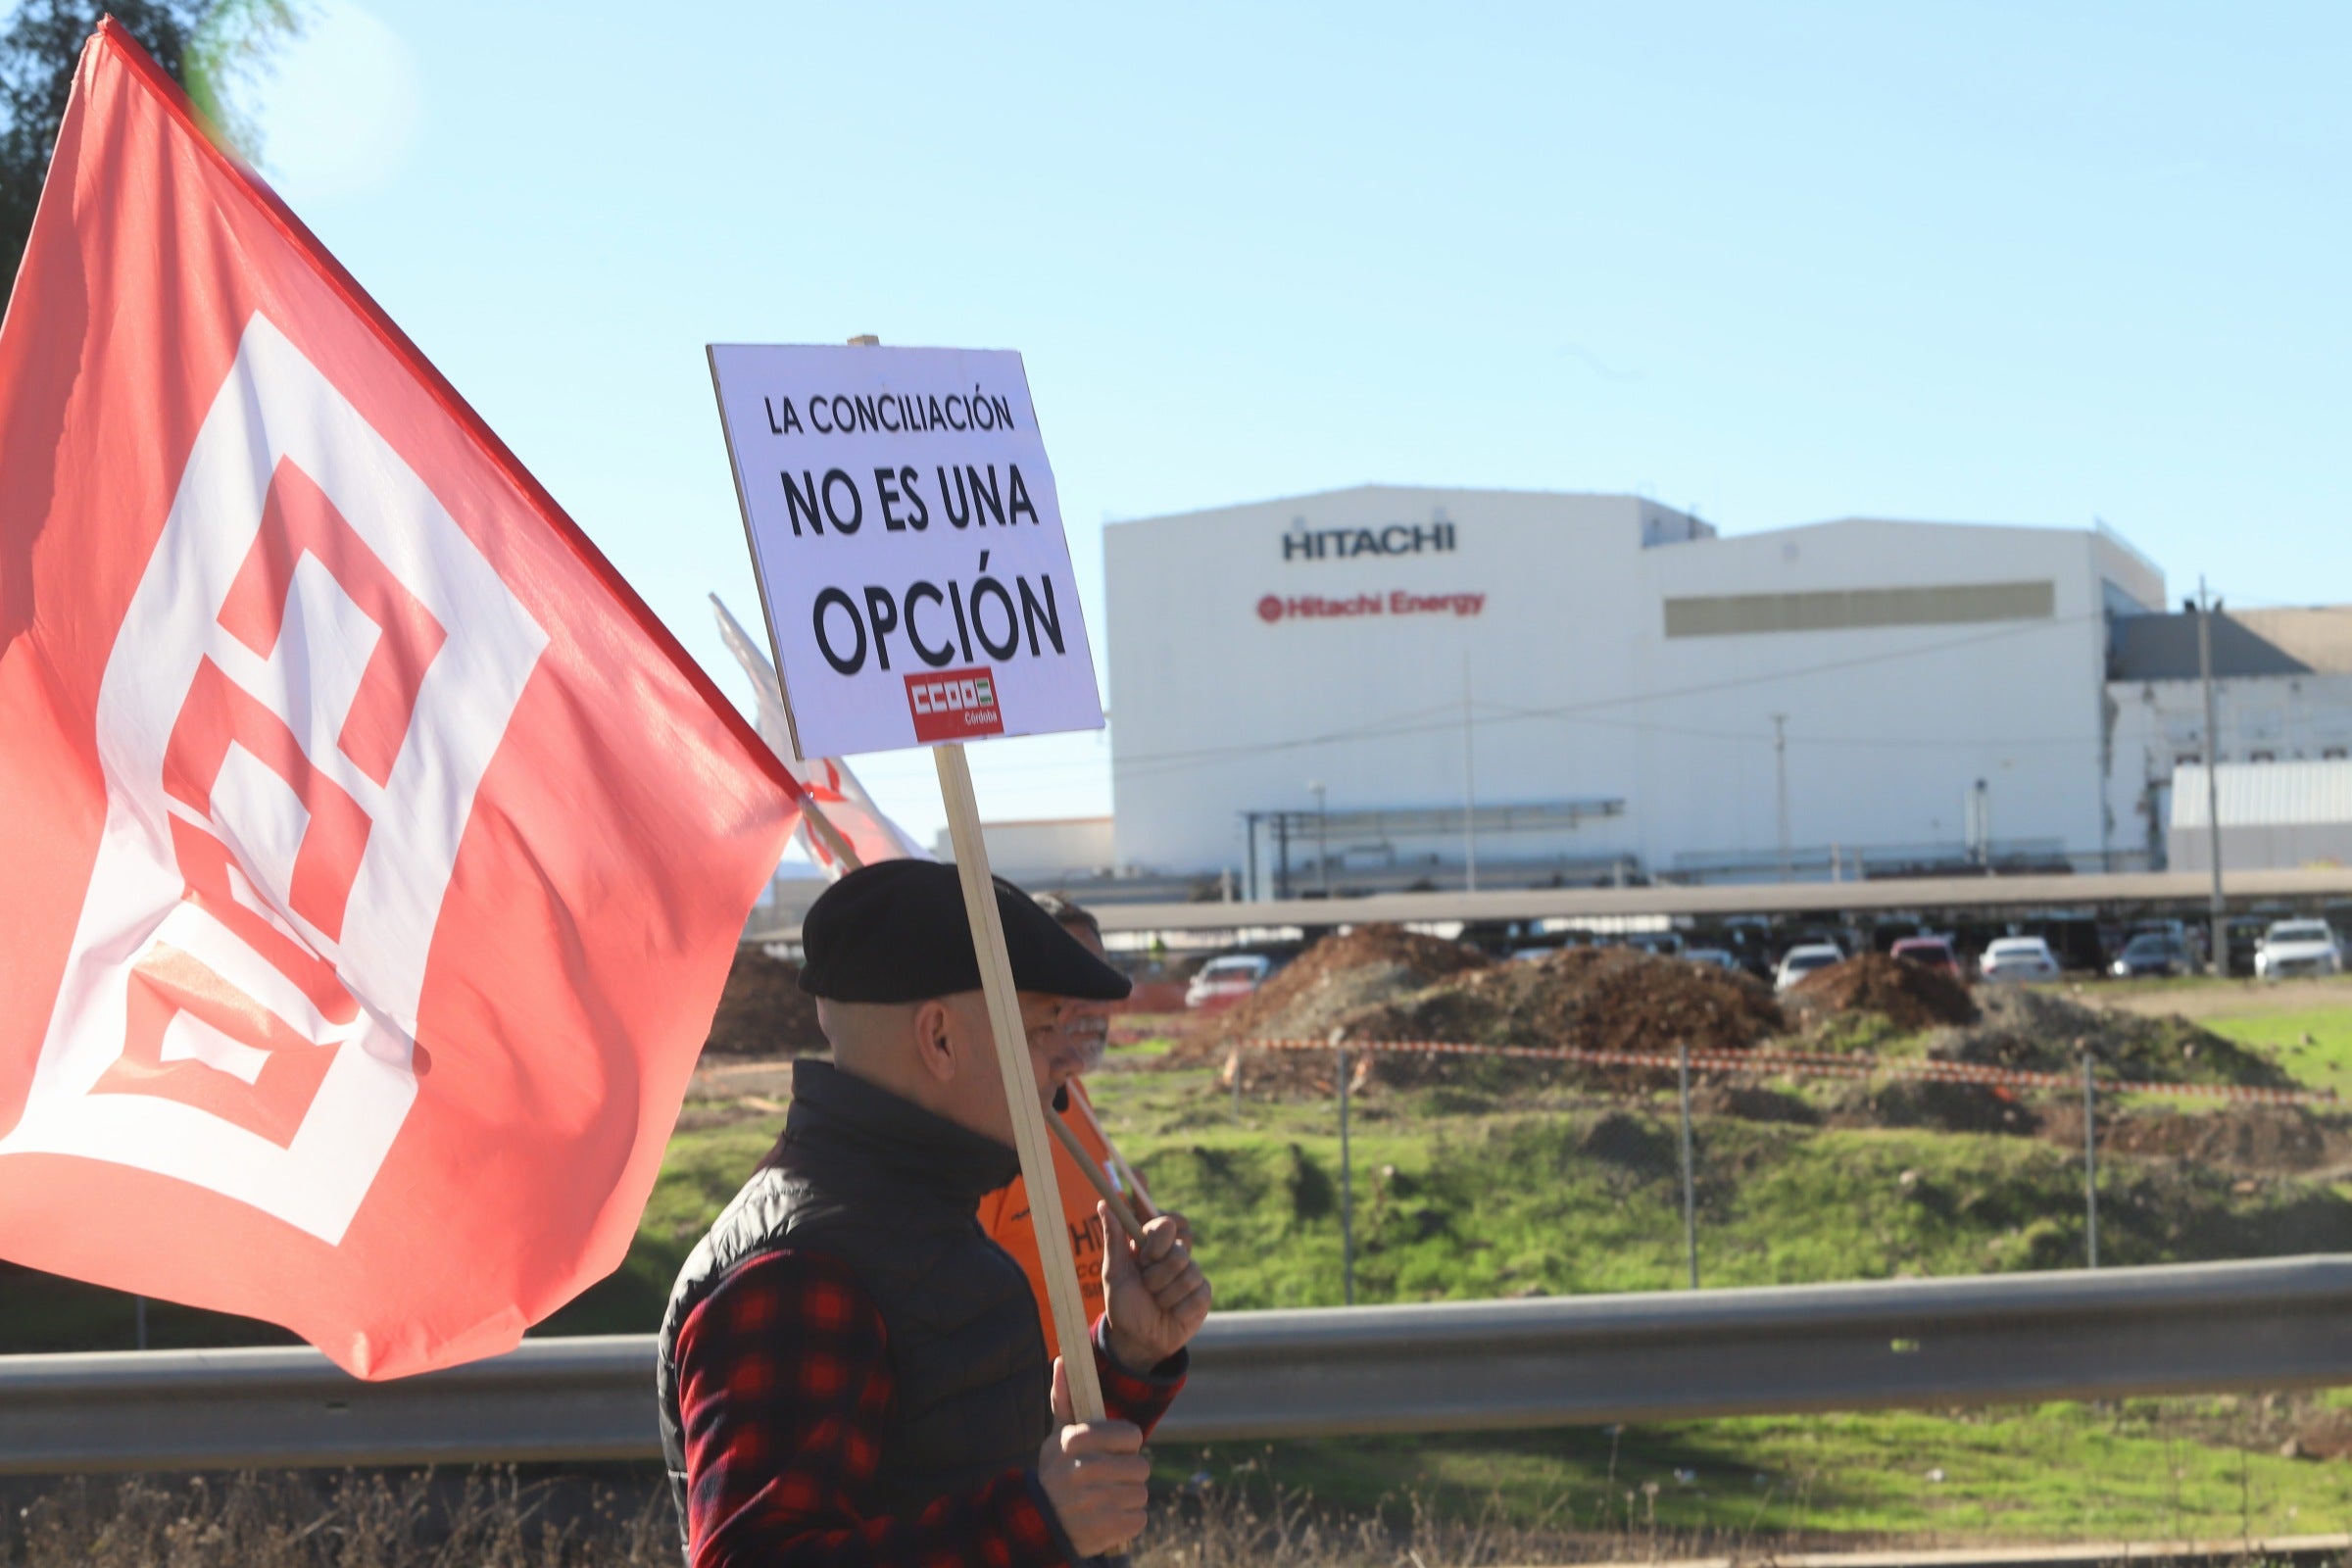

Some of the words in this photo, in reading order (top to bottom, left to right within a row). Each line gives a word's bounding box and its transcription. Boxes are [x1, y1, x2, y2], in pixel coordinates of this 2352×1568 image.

[764, 396, 804, 434] LA
[809, 383, 1015, 433] CONCILIACIÓN
[780, 467, 863, 536] NO
[874, 466, 929, 531] ES
[936, 464, 1040, 529] UNA
[1282, 522, 1456, 561] HITACHI
[812, 550, 1066, 676] OPCIÓN
[1286, 593, 1383, 618] Hitachi
[1390, 590, 1486, 616] Energy
[964, 710, 998, 725] Córdoba
